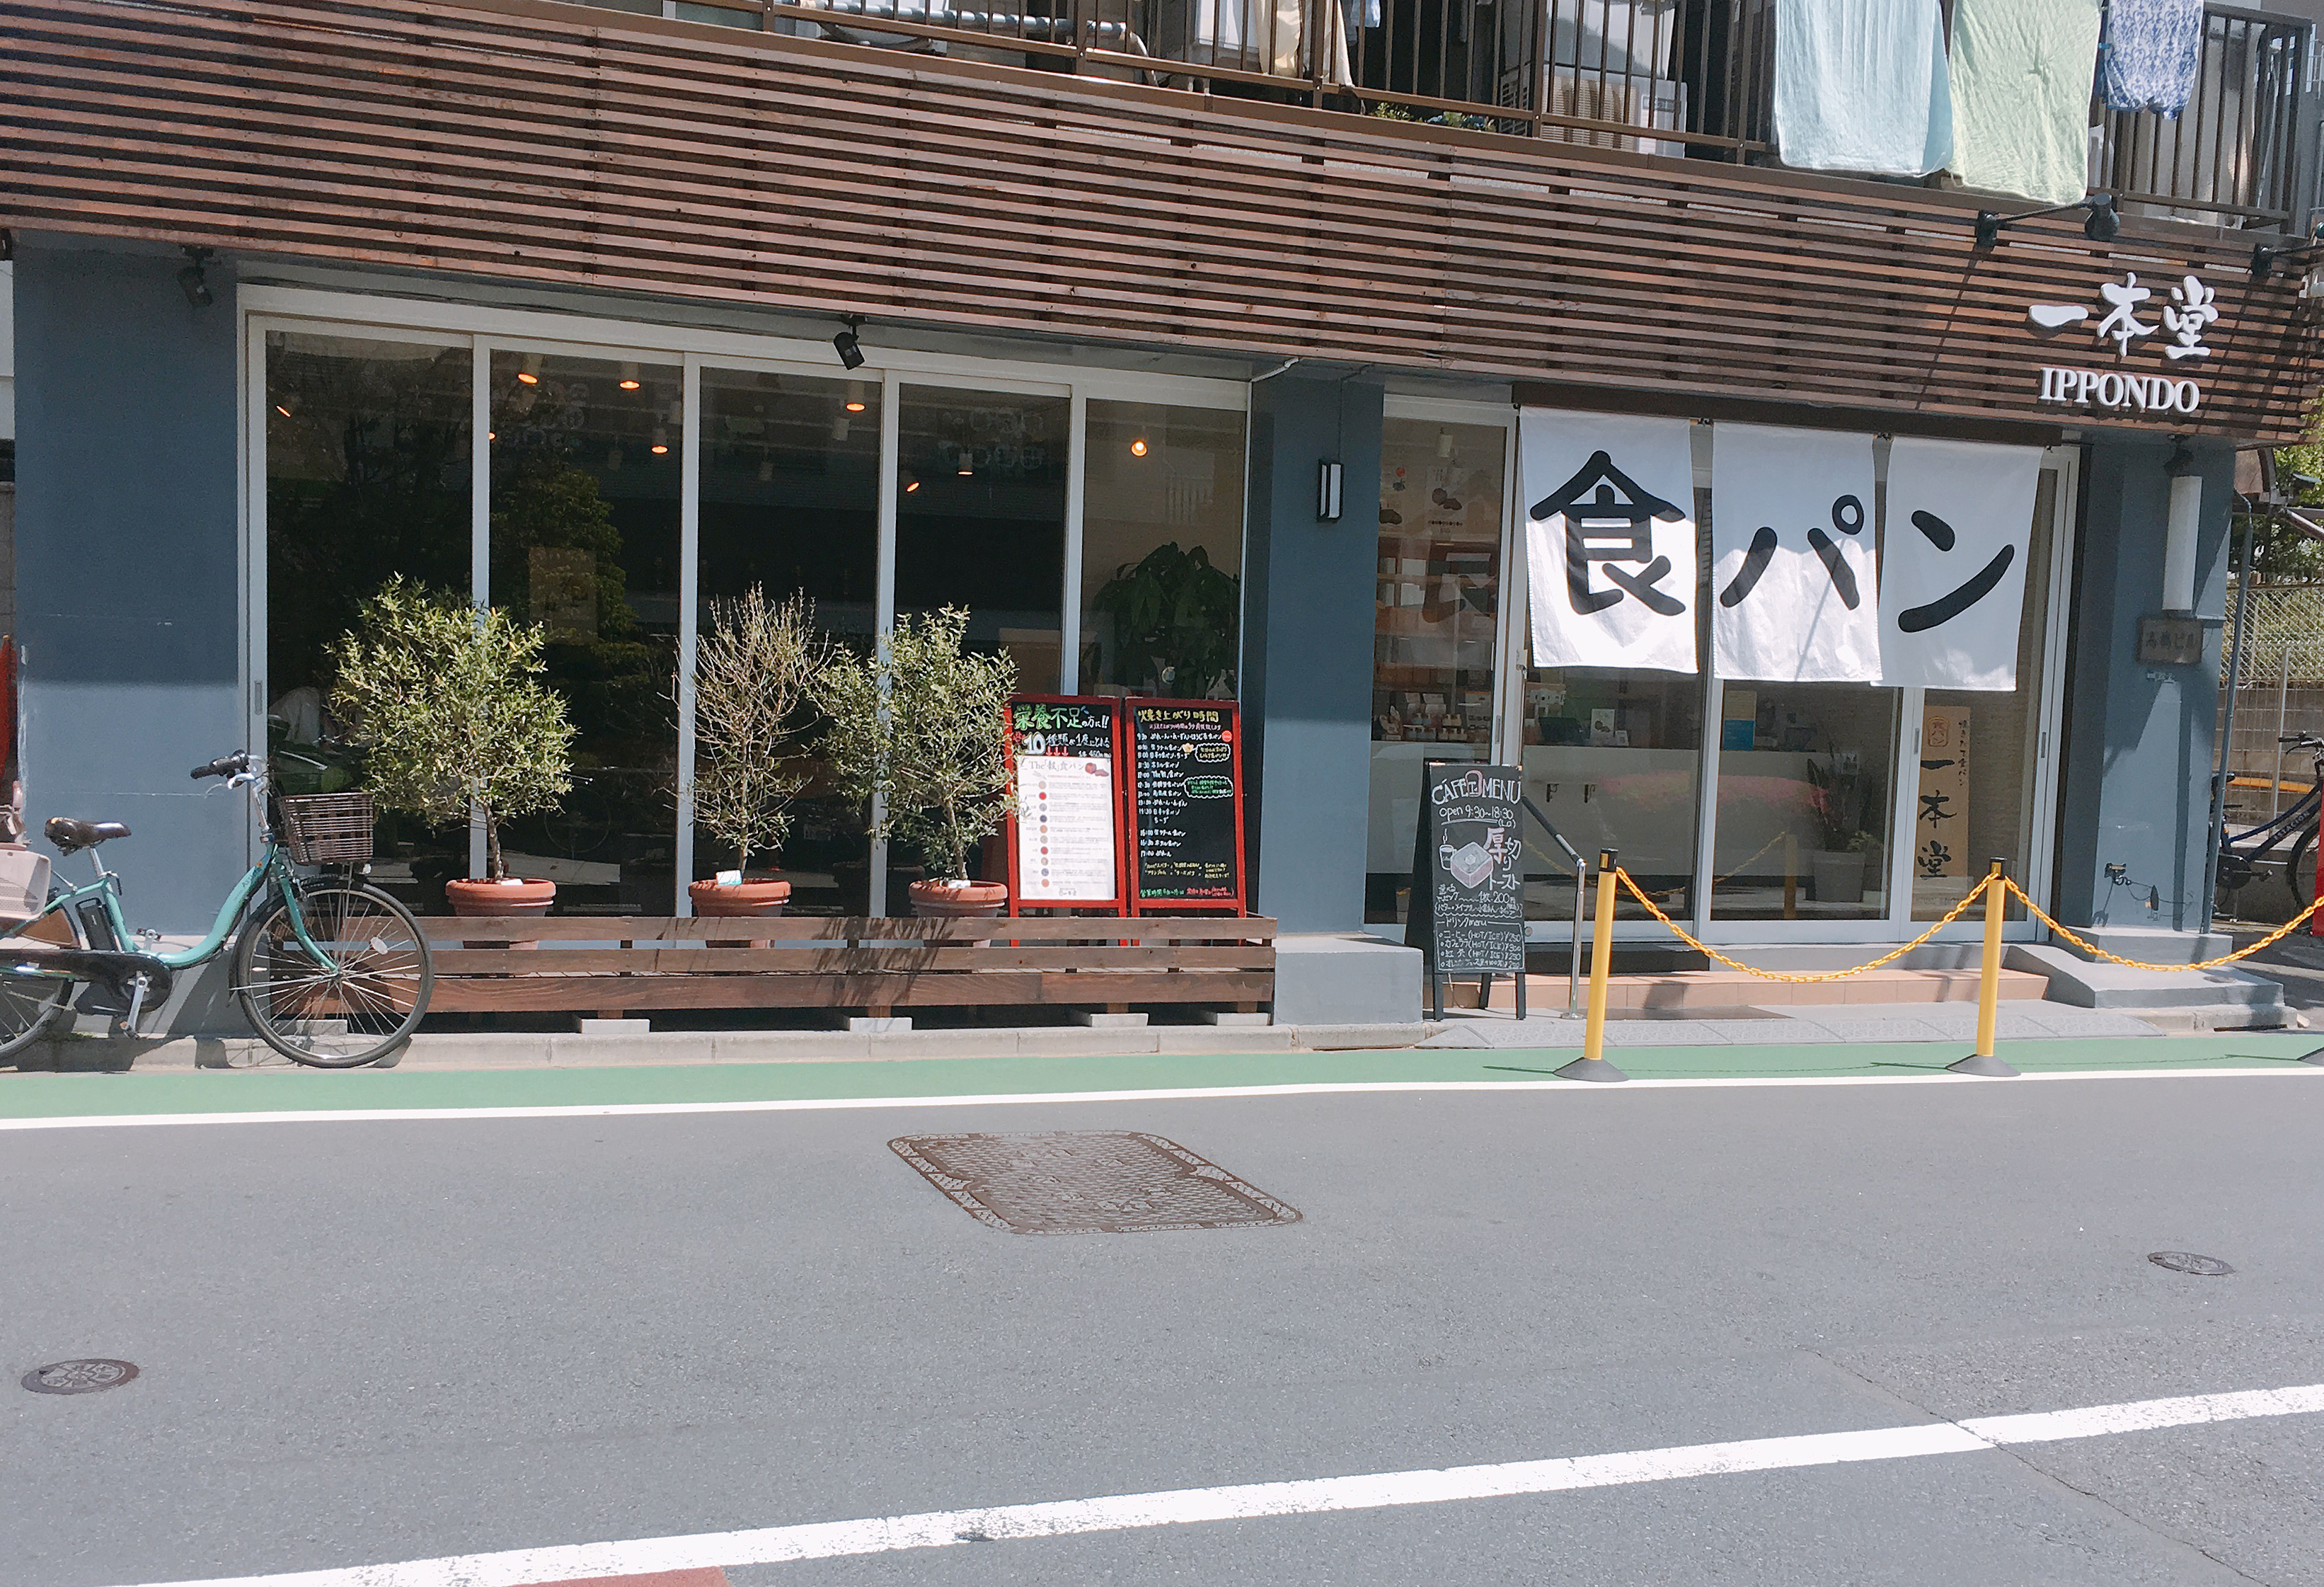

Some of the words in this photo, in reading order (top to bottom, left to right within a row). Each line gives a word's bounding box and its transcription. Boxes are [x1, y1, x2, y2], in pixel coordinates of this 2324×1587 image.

[2029, 273, 2219, 360] 一本堂
[2039, 367, 2200, 413] IPPONDO
[1530, 450, 2015, 634] 食パン
[1482, 778, 1521, 804] MENU
[1918, 760, 1957, 879] 一本堂
[1483, 827, 1521, 871] 厚切り
[1489, 873, 1521, 890] トースト
